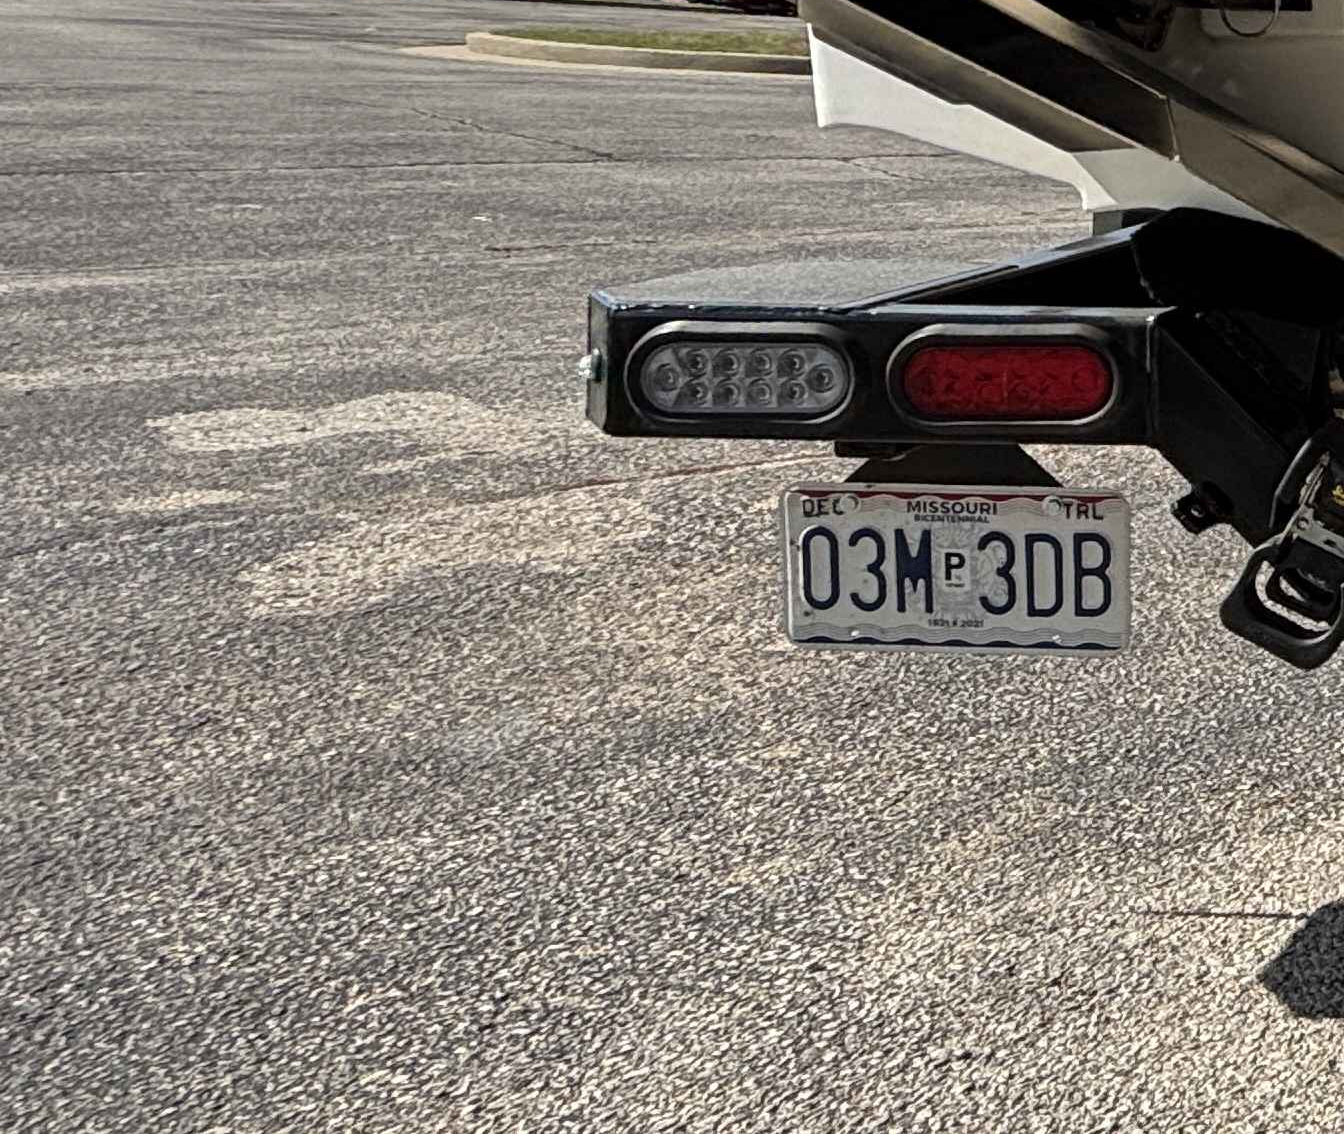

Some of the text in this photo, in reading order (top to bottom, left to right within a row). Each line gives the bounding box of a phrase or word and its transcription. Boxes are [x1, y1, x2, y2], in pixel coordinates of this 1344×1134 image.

[906, 500, 998, 516] MISSOURI
[1064, 500, 1104, 521] TRL
[914, 515, 990, 524] BICENTENNIAL
[944, 552, 966, 581] P
[977, 531, 1112, 618] 3DB
